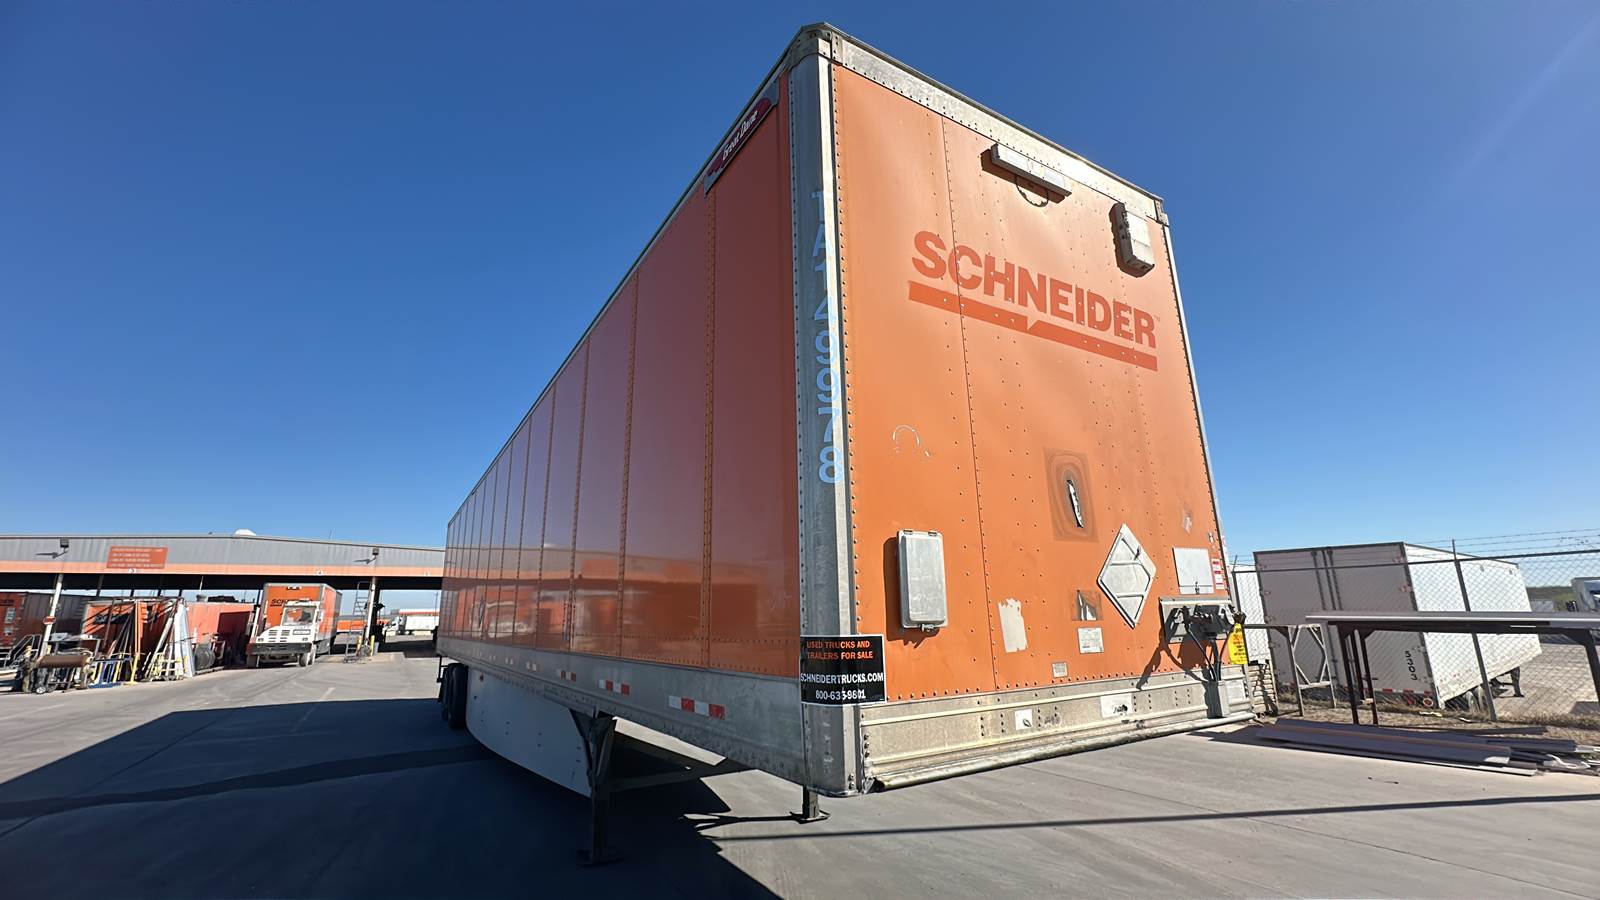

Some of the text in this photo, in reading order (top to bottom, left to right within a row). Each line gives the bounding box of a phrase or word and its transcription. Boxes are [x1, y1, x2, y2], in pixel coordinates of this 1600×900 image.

[739, 110, 759, 139] Dane
[911, 230, 1157, 349] SCHNEIDER
[806, 640, 871, 649] USED TRUCKS AND
[806, 651, 874, 660] TRAILERS FOR SALE
[800, 672, 884, 684] SCHNEIDERTRUCKS.COM
